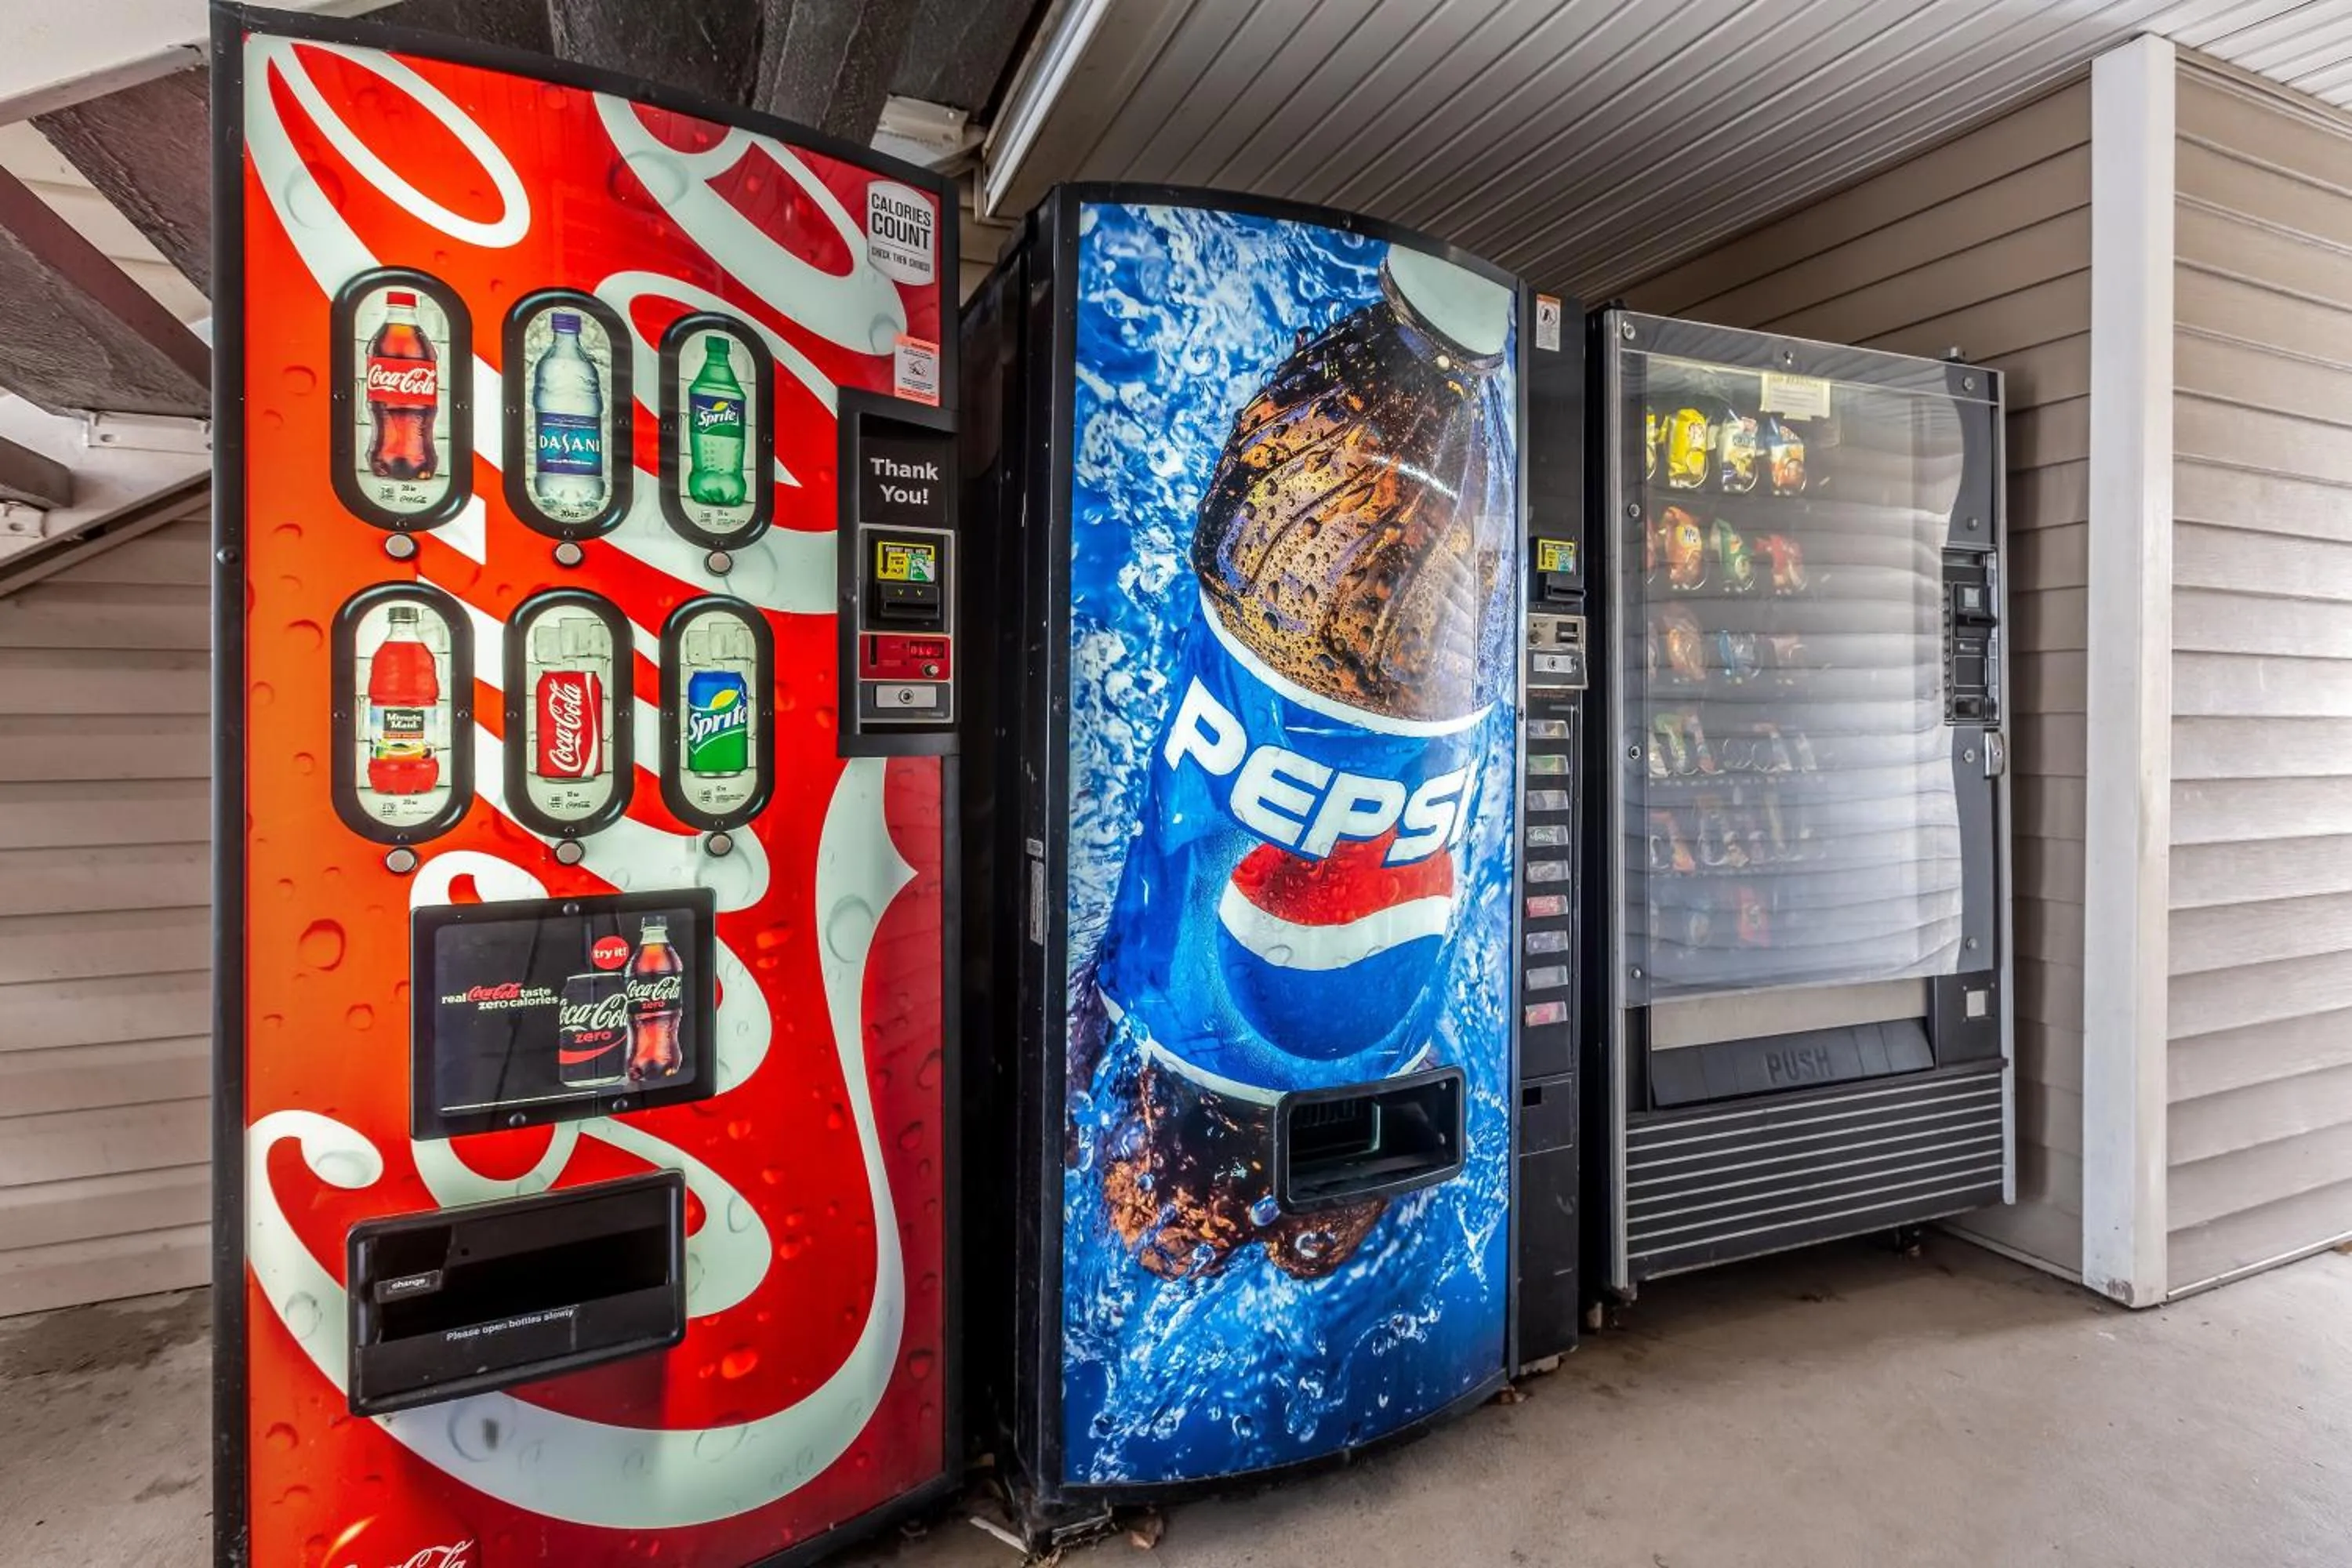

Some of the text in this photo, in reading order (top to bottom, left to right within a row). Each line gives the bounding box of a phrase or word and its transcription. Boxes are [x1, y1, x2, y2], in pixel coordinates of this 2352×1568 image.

[871, 193, 931, 227] CALORIES
[871, 212, 931, 250] COUNT
[368, 365, 435, 394] Coca-Cola
[698, 409, 735, 426] Sprite
[539, 434, 600, 453] DASANI
[870, 457, 939, 481] Thank
[880, 484, 929, 506] You!
[386, 713, 422, 721] Minute
[549, 679, 582, 772] Coca-Cola
[689, 705, 746, 743] Sprite
[1164, 675, 1479, 862] PEPSI
[593, 946, 627, 959] try it!
[441, 993, 466, 1004] real
[520, 987, 552, 998] taste
[478, 996, 558, 1011] zero calories
[642, 1000, 666, 1009] zero
[574, 1031, 612, 1043] zero
[1765, 1045, 1834, 1085] PUSH
[391, 1278, 425, 1290] change
[446, 1308, 574, 1341] Please open bottles slowly
